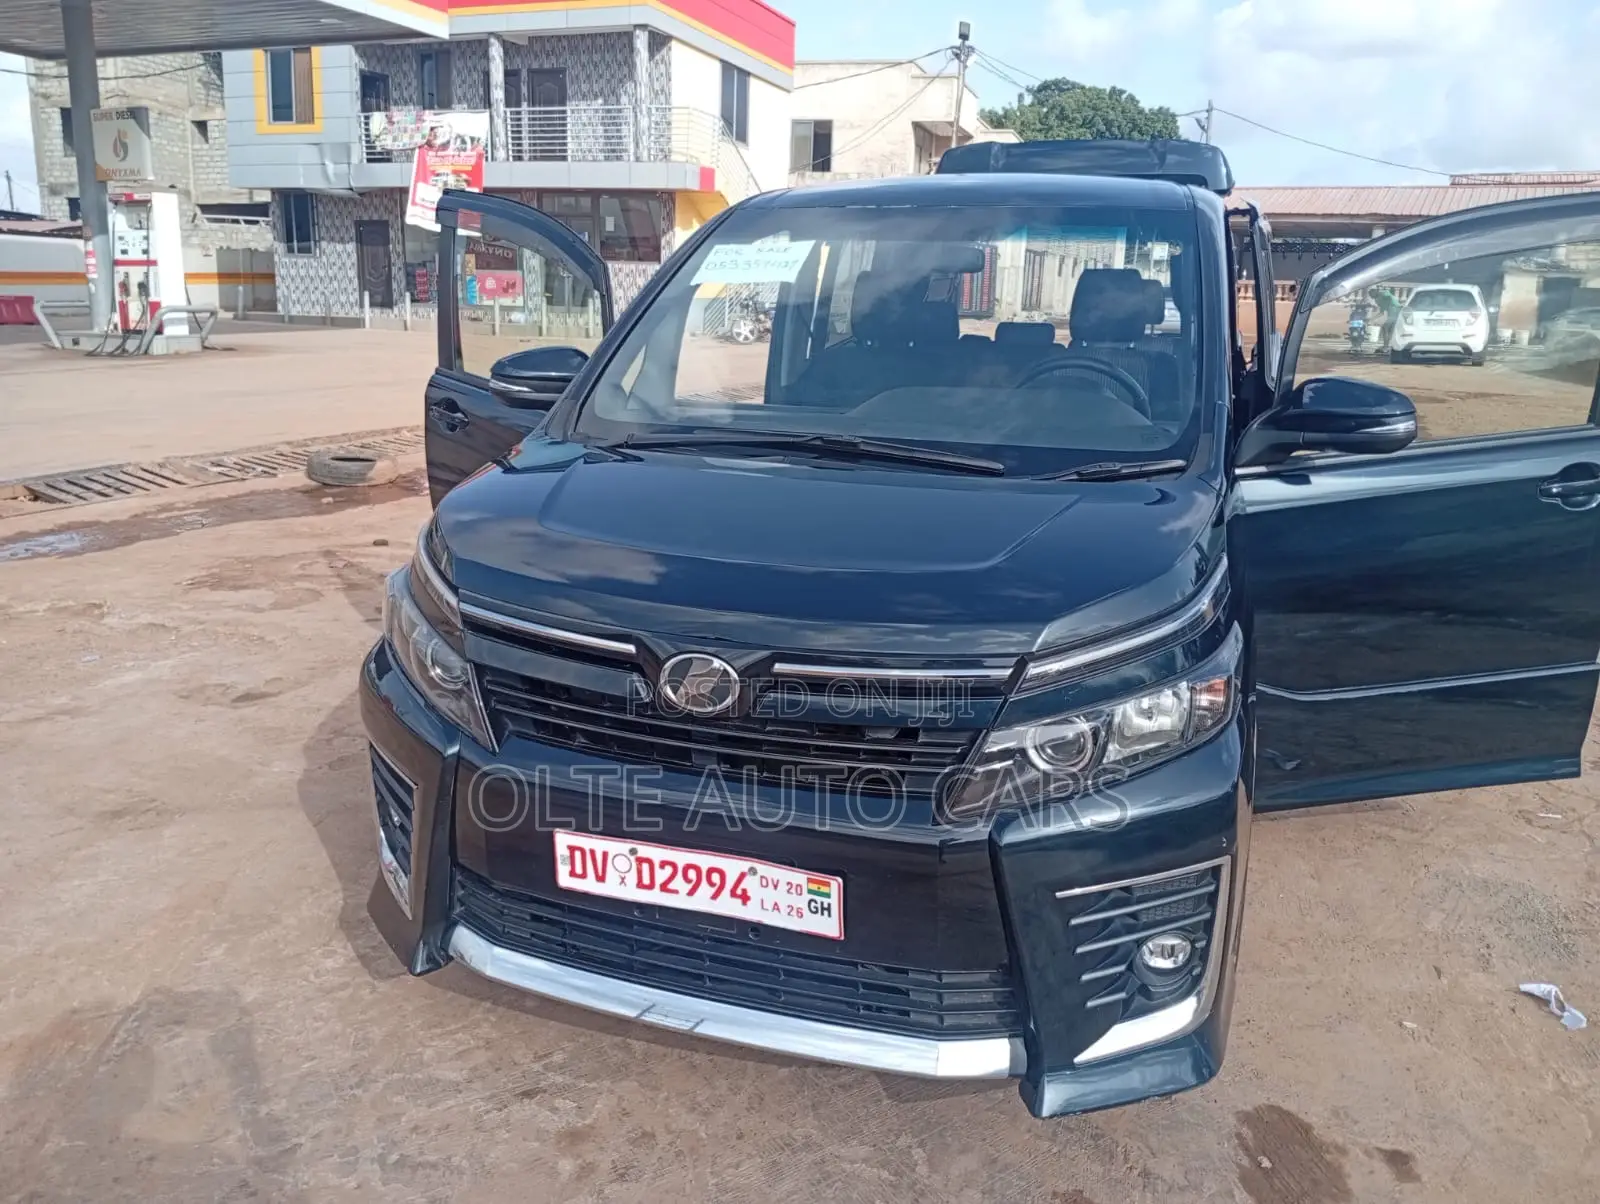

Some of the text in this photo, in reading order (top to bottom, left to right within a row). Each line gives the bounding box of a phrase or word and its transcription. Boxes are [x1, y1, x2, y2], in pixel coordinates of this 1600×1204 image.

[566, 844, 609, 884] DV
[635, 855, 752, 906] D2994
[759, 875, 804, 897] DV 20
[760, 898, 782, 914] LA
[807, 898, 833, 919] GH
